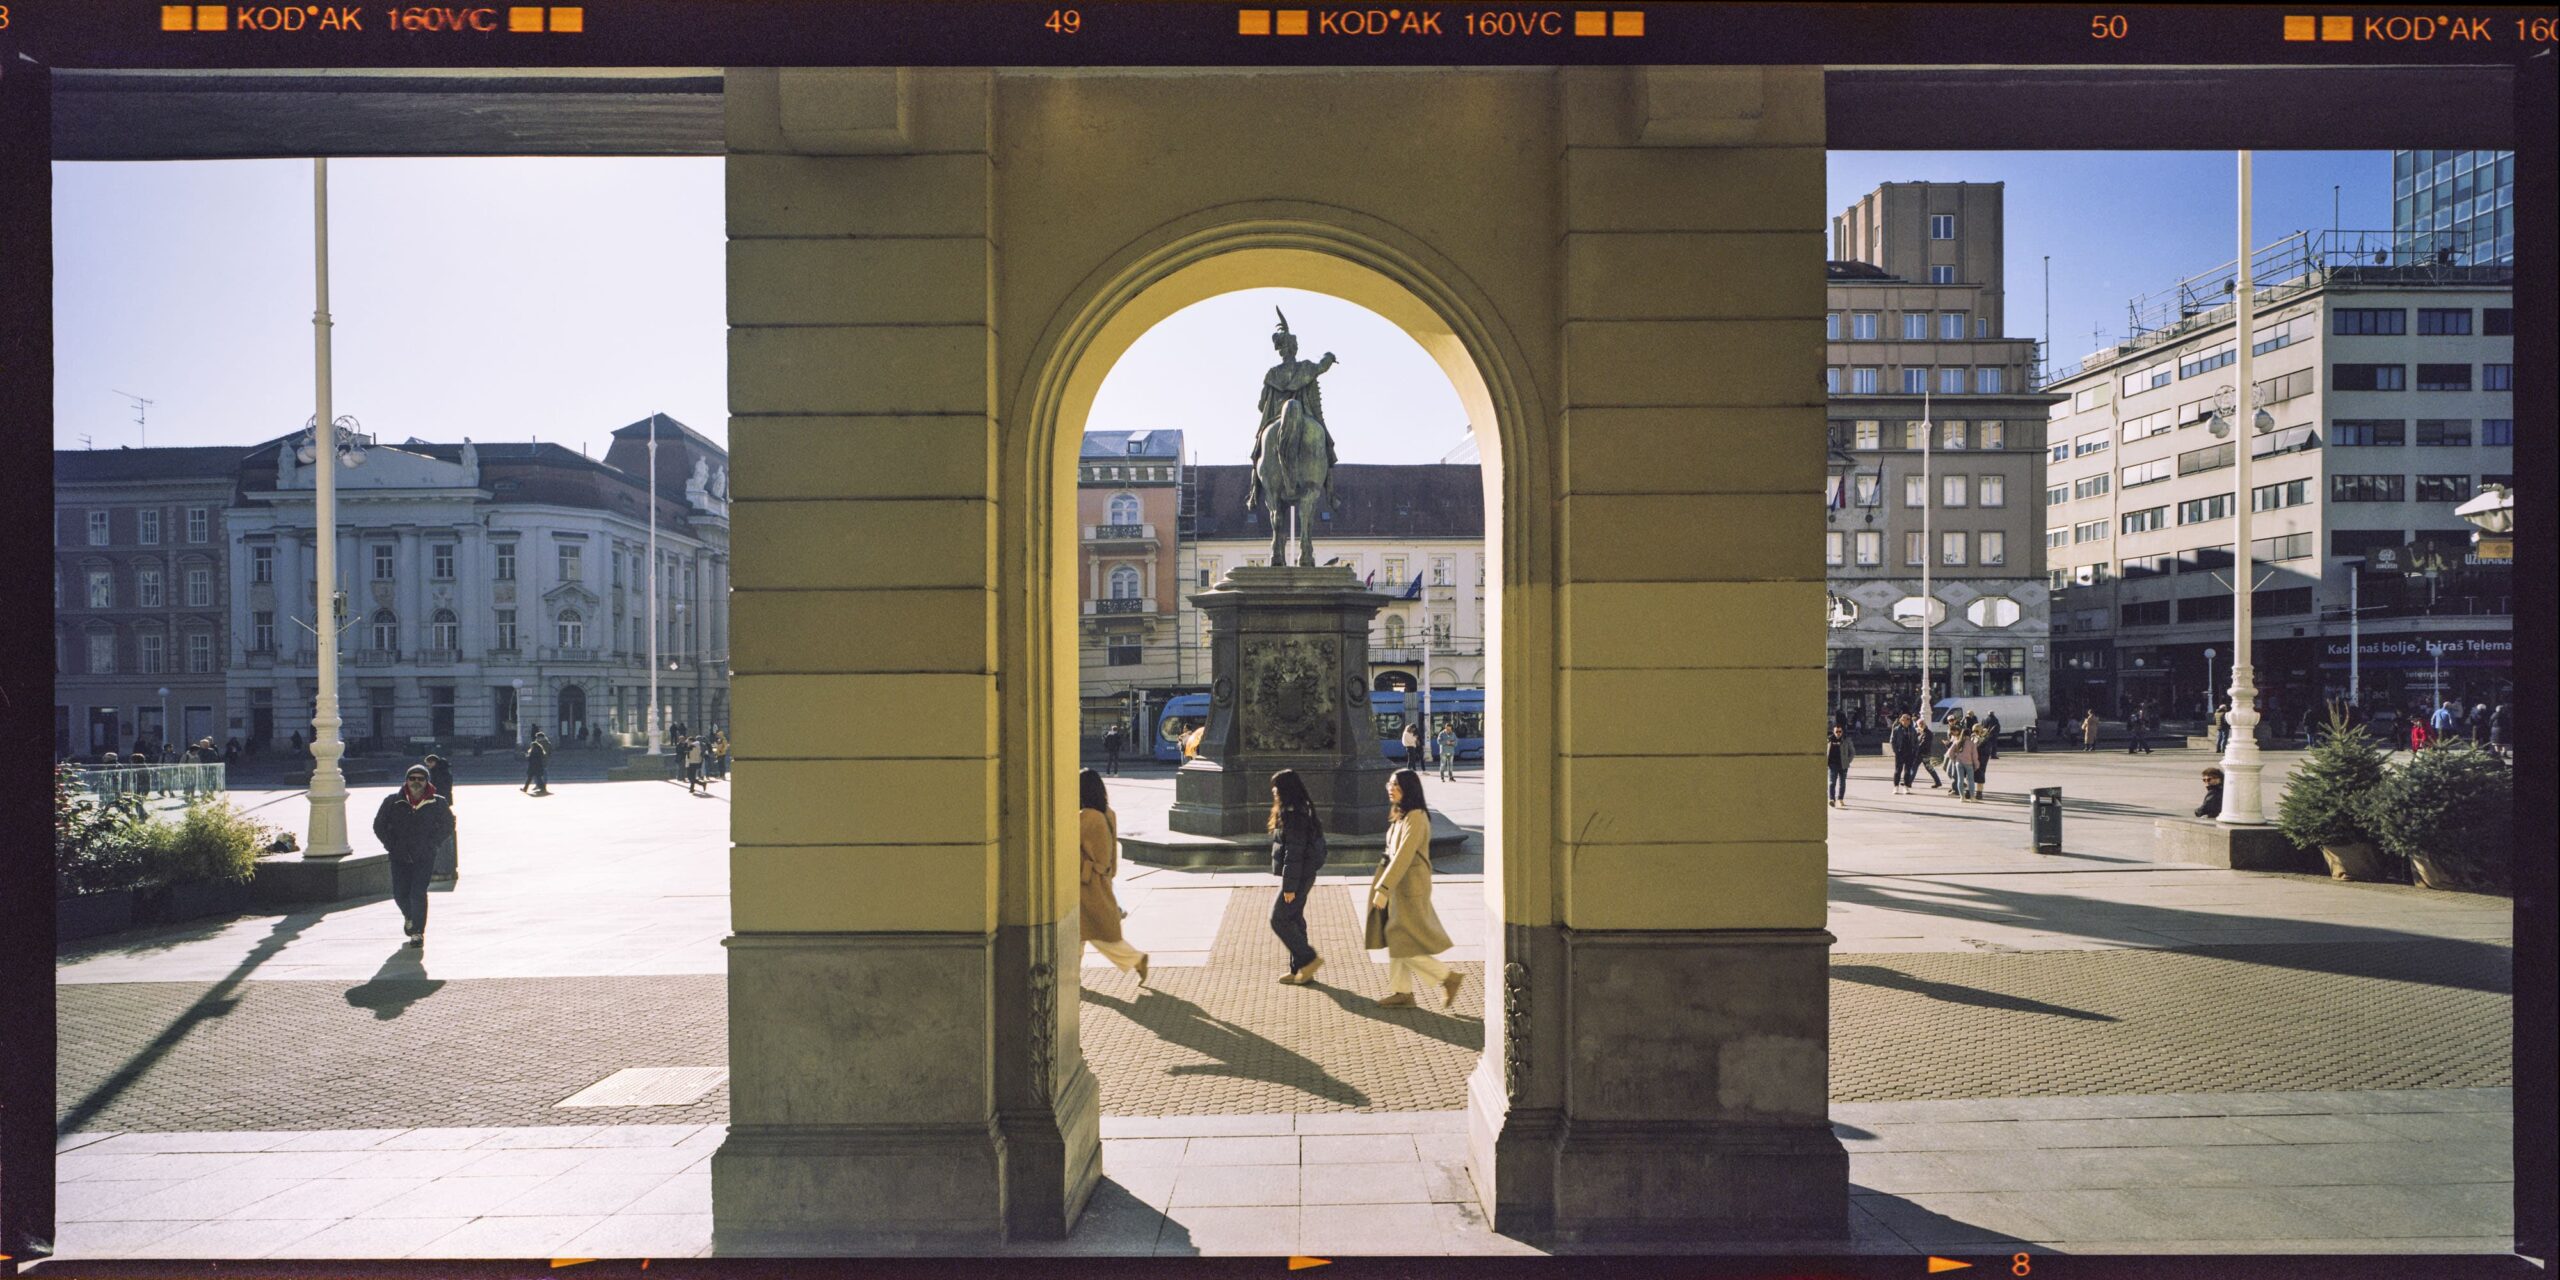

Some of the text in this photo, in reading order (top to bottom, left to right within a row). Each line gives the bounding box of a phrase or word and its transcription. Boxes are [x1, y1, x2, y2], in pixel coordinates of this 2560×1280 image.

[387, 7, 496, 32] 160VC
[1045, 10, 1081, 33] 49
[1465, 11, 1562, 36] 160VC
[2092, 16, 2128, 39] 50
[2328, 639, 2513, 655] Kad naš bolje, biraš Telema
[2012, 1252, 2031, 1277] 8
